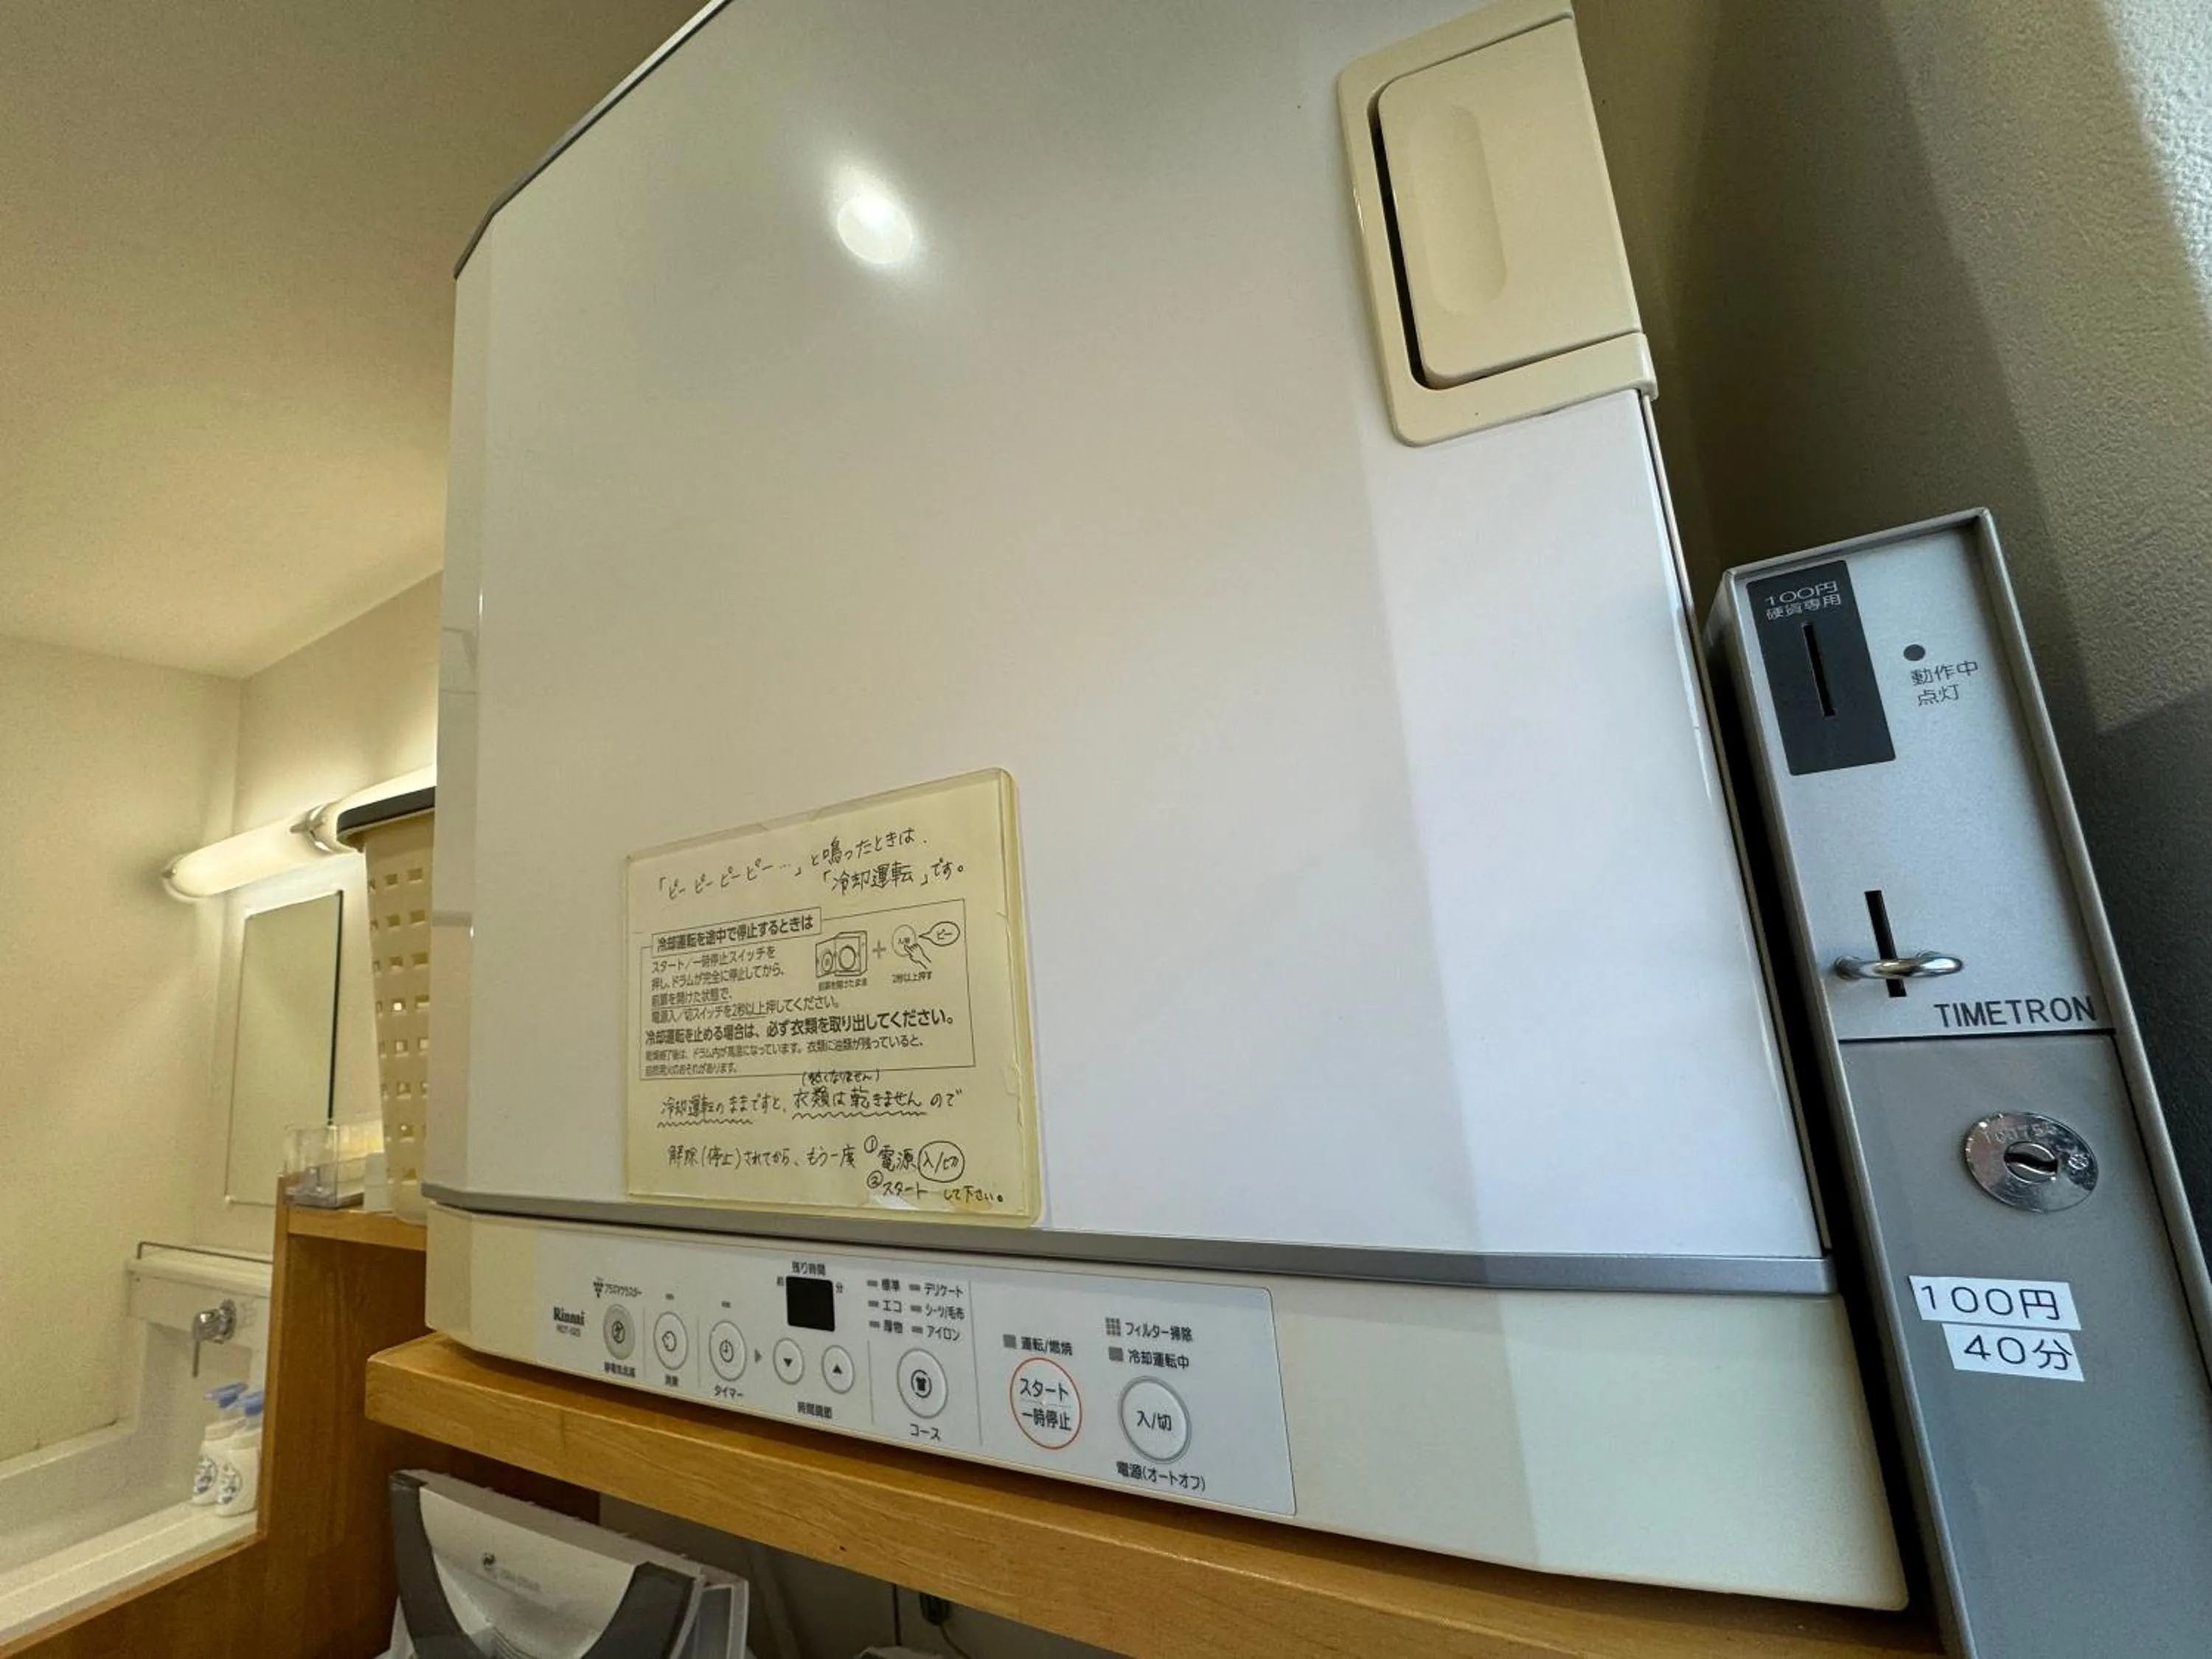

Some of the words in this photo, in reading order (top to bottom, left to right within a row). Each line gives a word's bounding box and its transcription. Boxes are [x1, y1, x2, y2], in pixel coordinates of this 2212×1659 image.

[1765, 581, 1837, 605] 100円
[1911, 661, 1978, 686] 動作中
[1917, 684, 1959, 706] 点灯
[657, 915, 813, 952] 冷却運転を途中で停止するときは
[1933, 995, 2098, 1028] TIMETRON
[792, 1261, 826, 1276] 残り時間
[836, 1282, 844, 1293] 分
[924, 1282, 964, 1298] デリケート
[883, 1300, 902, 1312] エコ
[1921, 1284, 2061, 1321] 100円
[554, 1307, 585, 1325] Rinnai
[927, 1325, 961, 1341] アイロン
[1125, 1321, 1193, 1343] フィルター掃除
[1020, 1336, 1074, 1356] 運転/燃焼
[1964, 1335, 2073, 1371] 40分
[1127, 1349, 1190, 1369] 冷却運転中
[714, 1385, 744, 1399] タイマー
[1020, 1379, 1069, 1400] スタート
[1021, 1409, 1072, 1432] 一時停止
[1136, 1410, 1172, 1433] 入/切
[910, 1425, 941, 1441] コース
